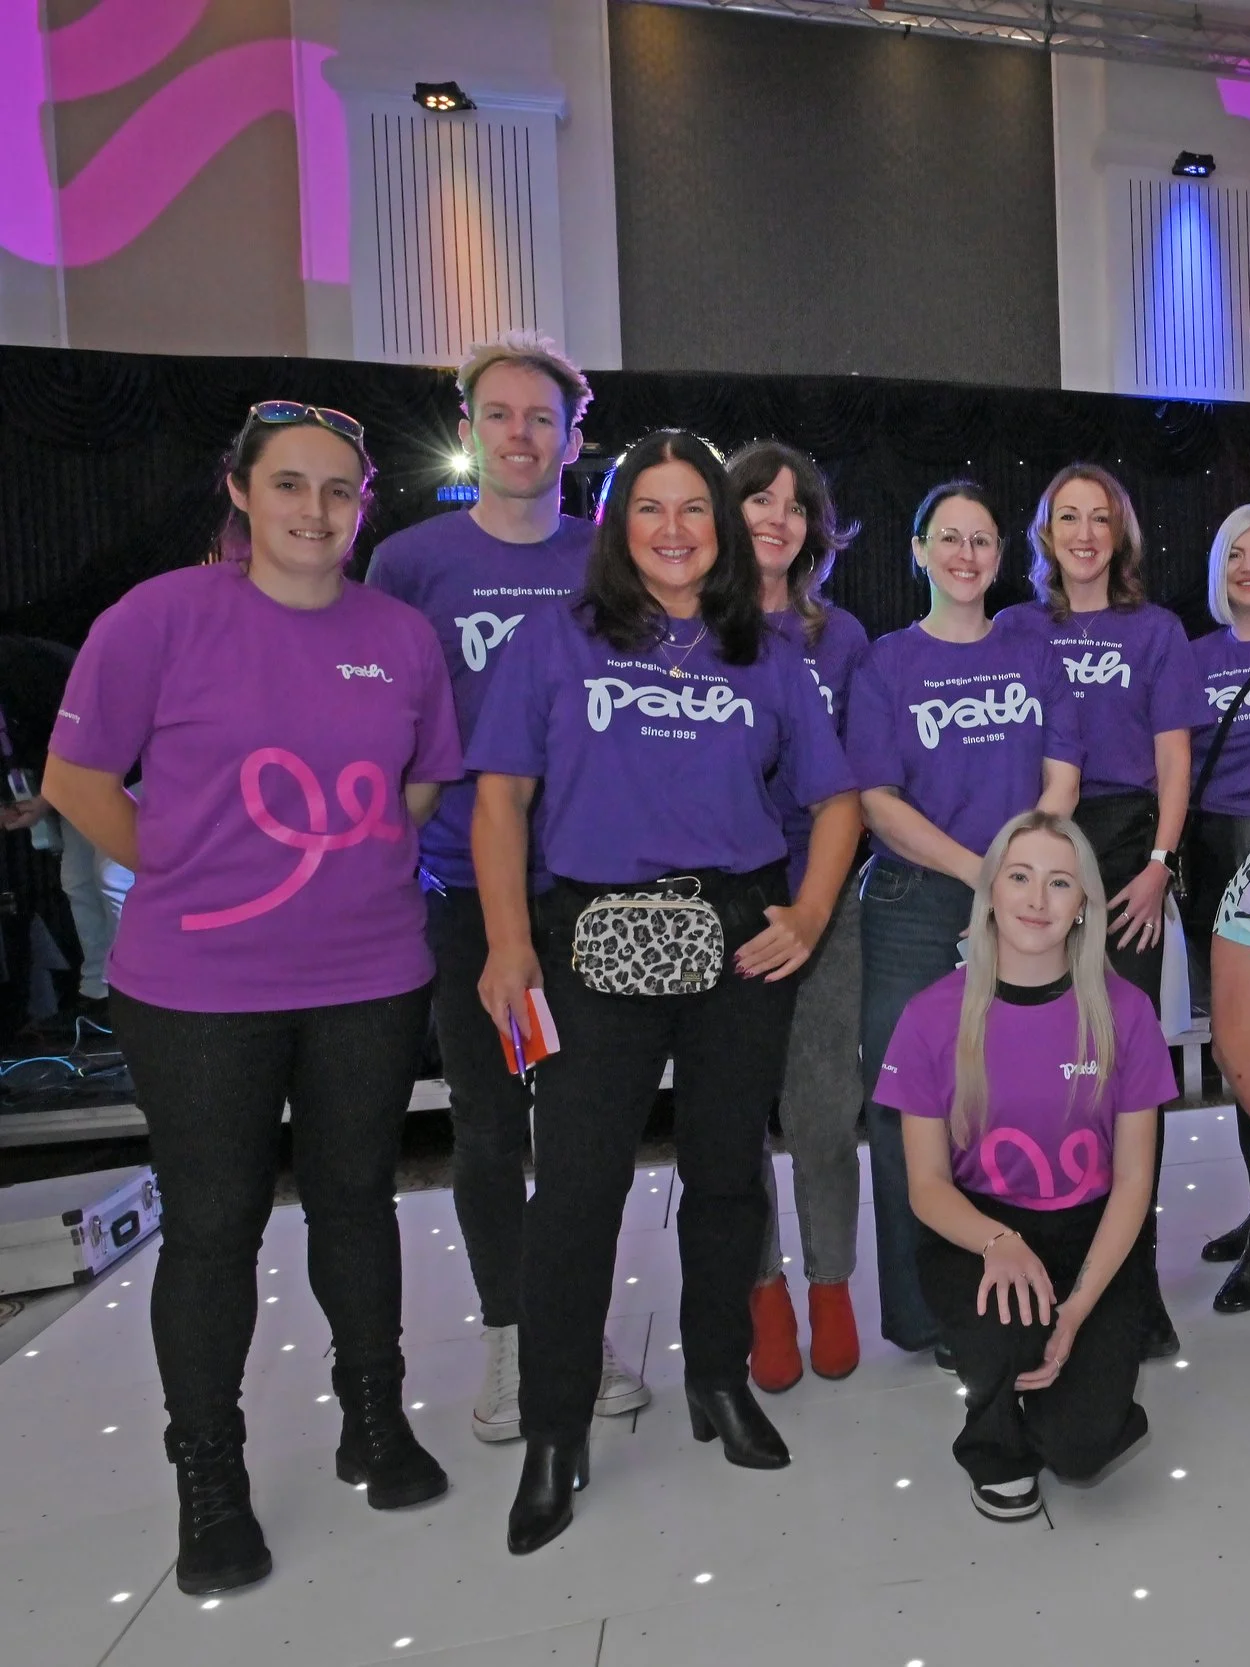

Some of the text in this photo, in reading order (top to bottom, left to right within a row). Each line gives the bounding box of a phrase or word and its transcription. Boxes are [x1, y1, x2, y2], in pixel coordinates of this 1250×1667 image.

[473, 588, 498, 596] Hope
[500, 587, 532, 596] Begins
[534, 587, 555, 596] with
[336, 664, 393, 683] path
[607, 659, 633, 668] Hope
[635, 661, 667, 675] Begins
[701, 674, 729, 683] Home
[924, 680, 945, 688] Hope
[946, 678, 972, 686] Begins
[998, 672, 1021, 680] Home
[584, 677, 753, 732] path
[909, 682, 1042, 749] path
[640, 725, 697, 740] Since 1995
[963, 733, 1005, 744] Since 1995
